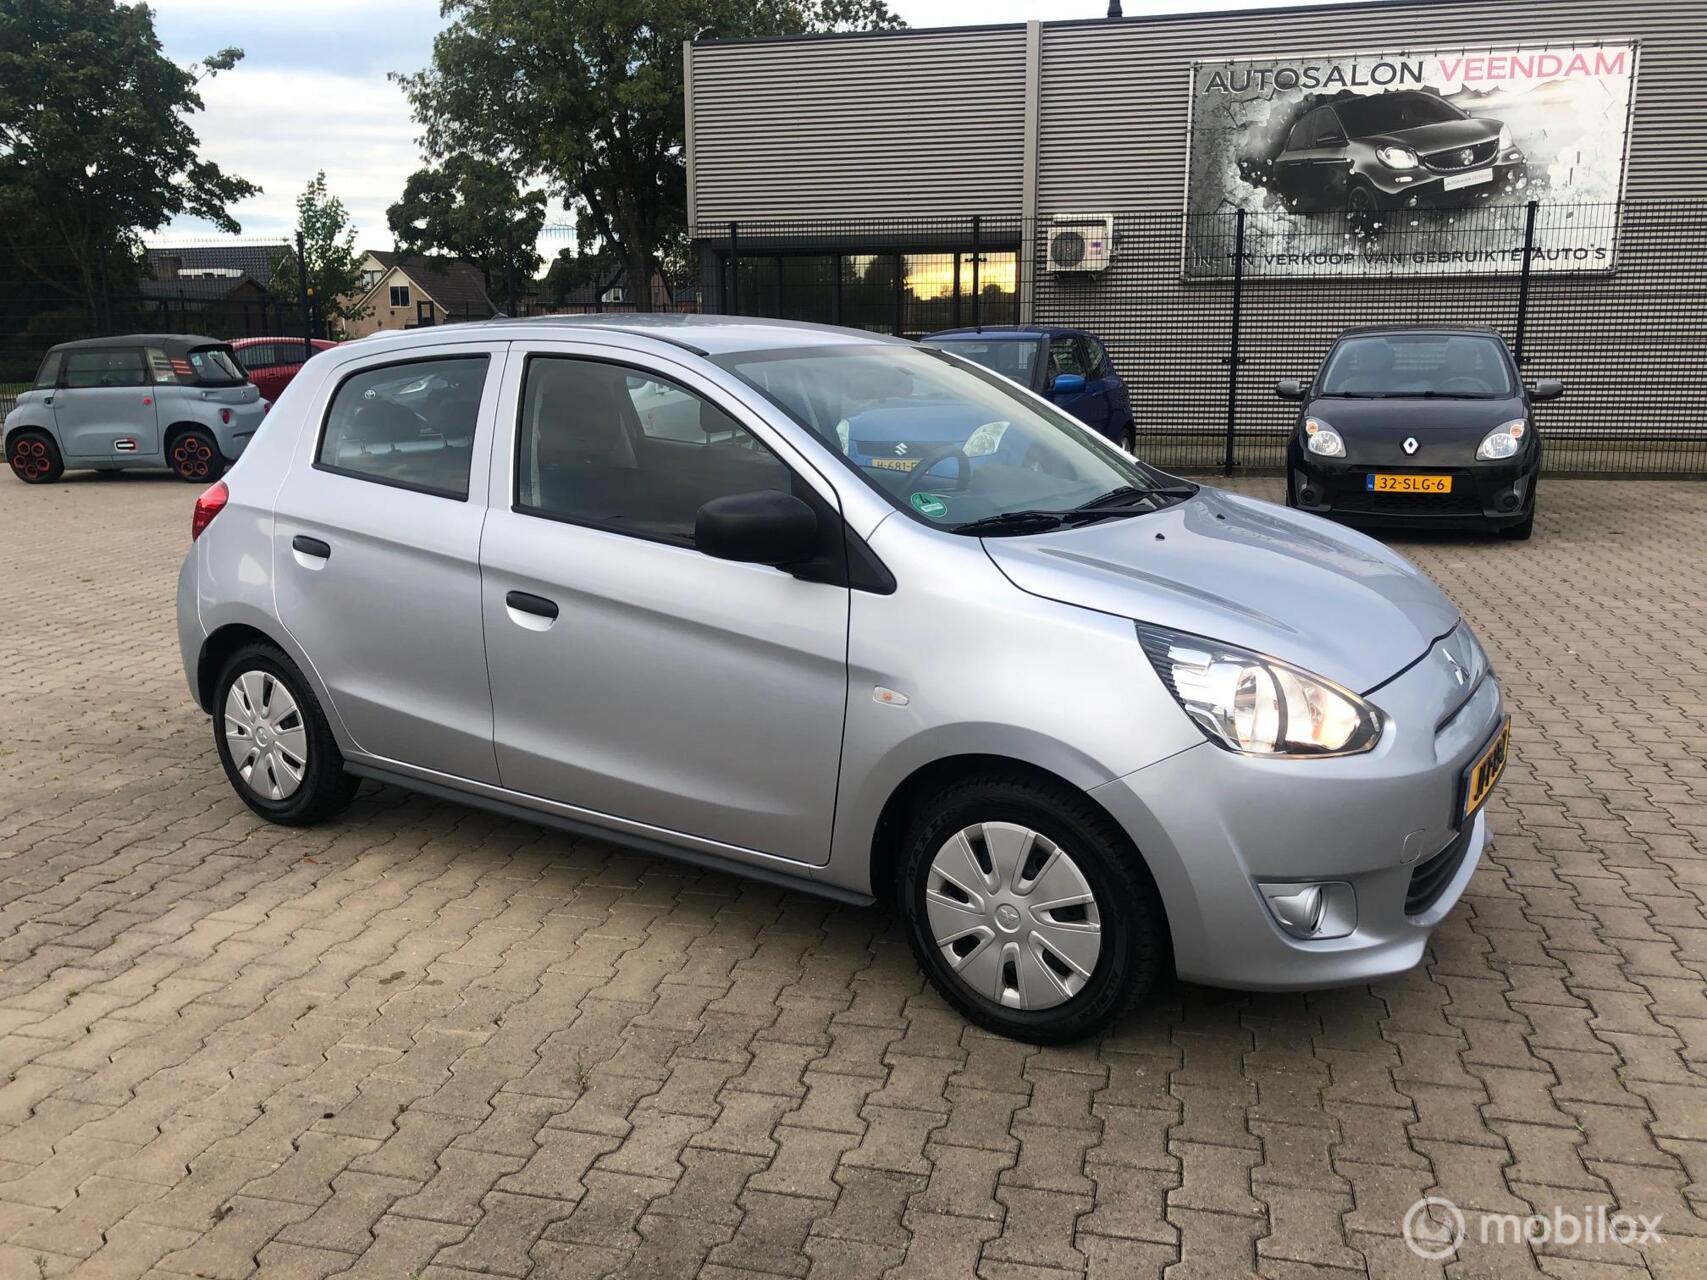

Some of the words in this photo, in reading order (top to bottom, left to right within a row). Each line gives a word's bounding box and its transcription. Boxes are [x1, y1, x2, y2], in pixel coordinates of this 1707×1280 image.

[1202, 61, 1424, 94] AUTOSALON
[1438, 51, 1626, 82] VEENDAM
[1263, 252, 1356, 266] VERKOOP
[1363, 252, 1401, 264] VAN
[1411, 248, 1522, 264] GEBRUIKTE
[1531, 243, 1606, 261] AUTO'S
[1379, 477, 1446, 491] 32-SLG-6
